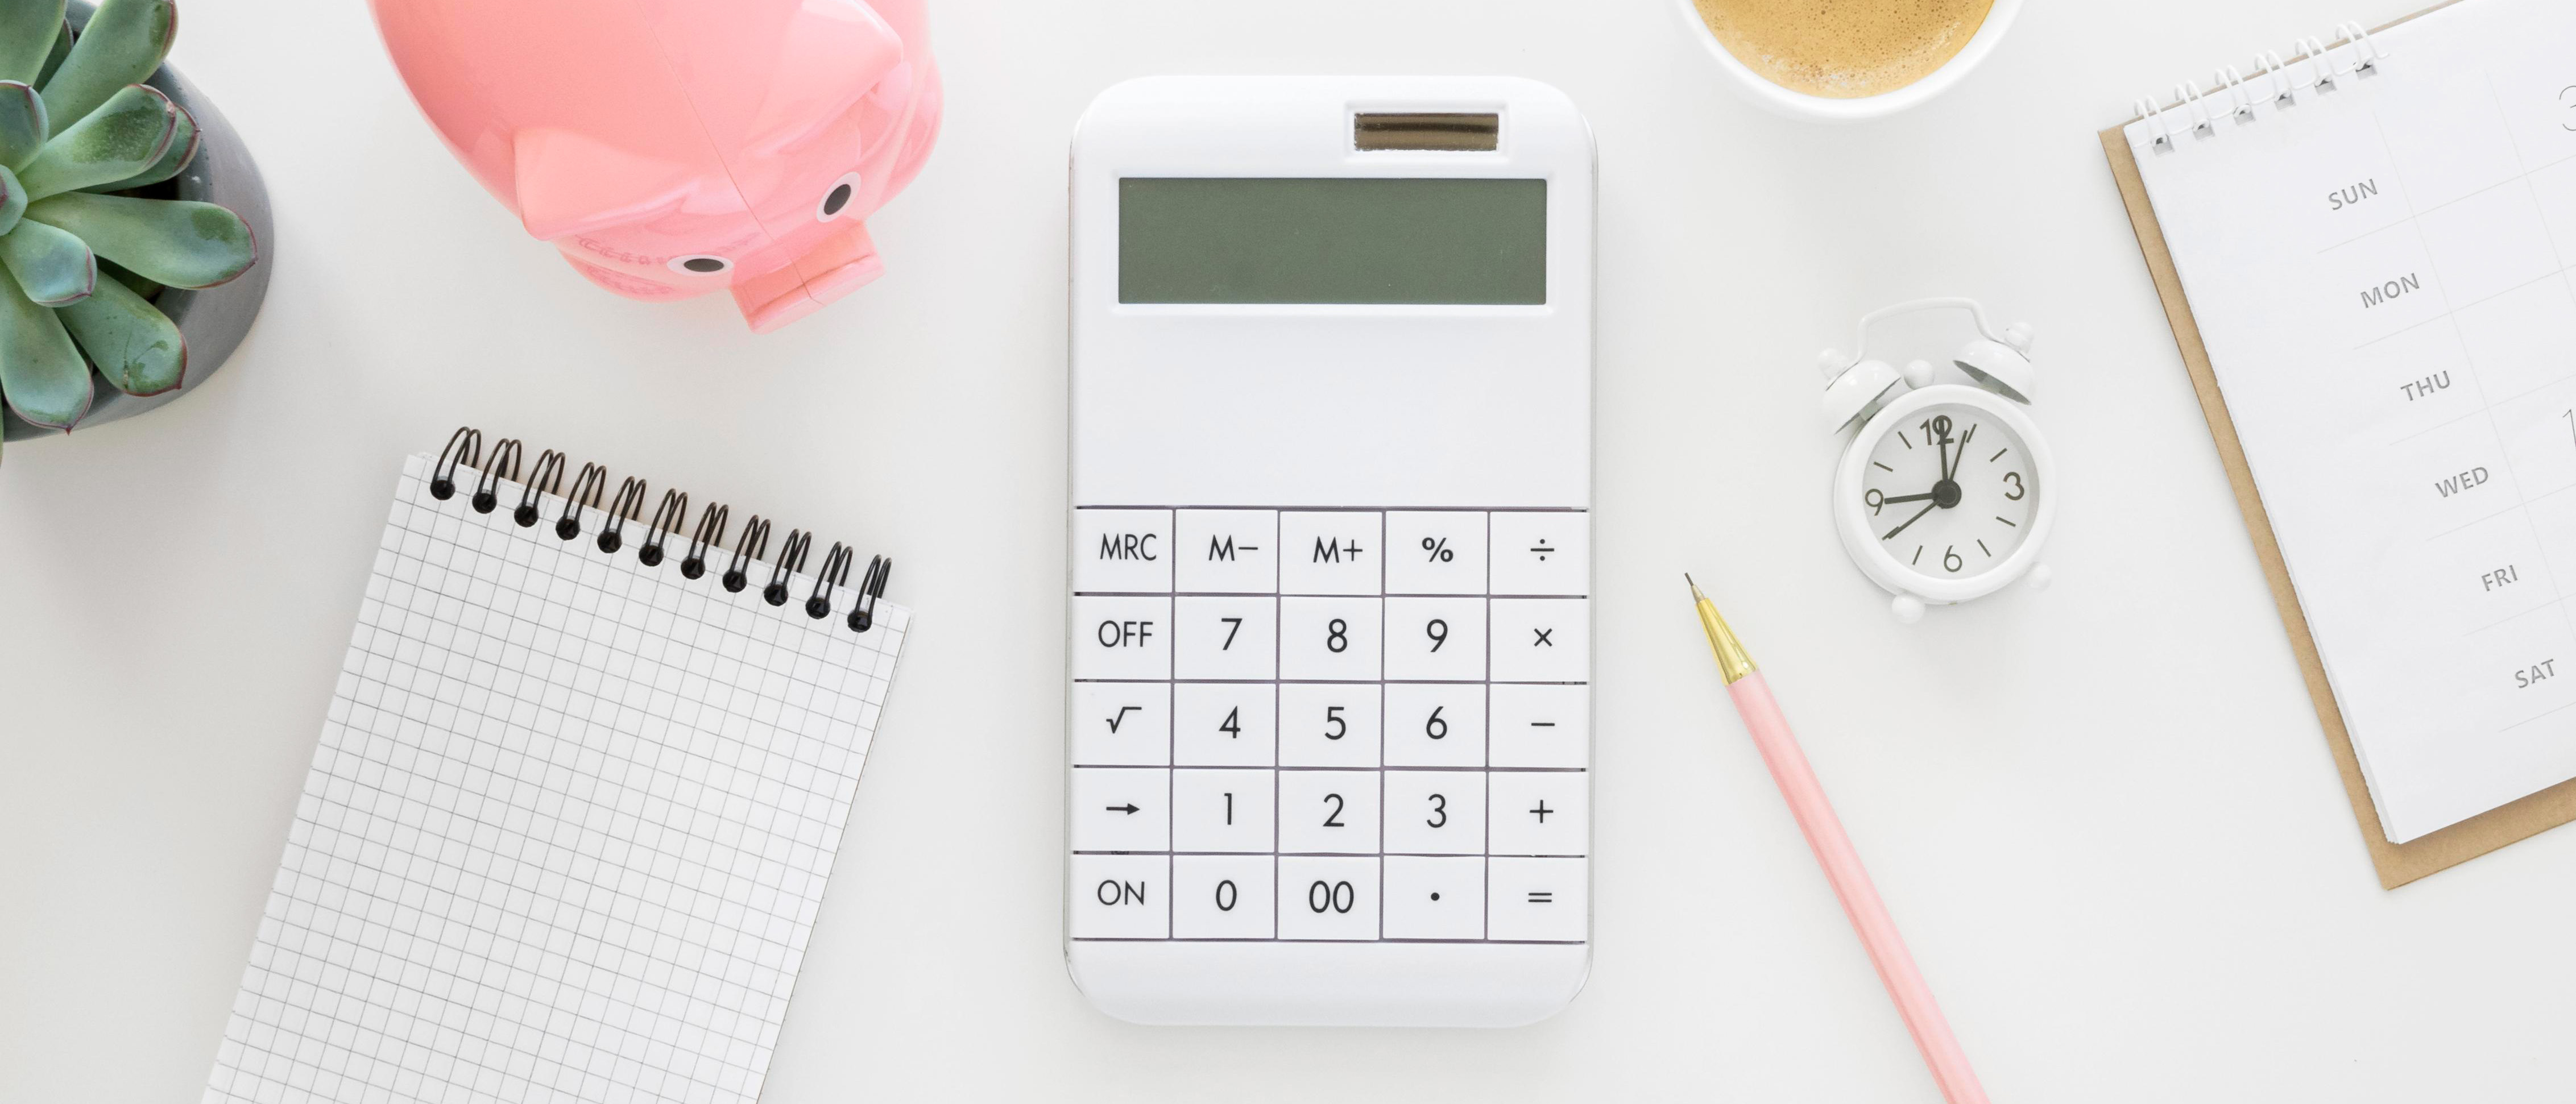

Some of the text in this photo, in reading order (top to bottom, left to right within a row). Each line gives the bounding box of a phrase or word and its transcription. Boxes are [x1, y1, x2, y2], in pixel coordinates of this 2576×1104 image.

[2328, 179, 2378, 210] SUN
[2360, 272, 2420, 309] MON
[2400, 370, 2450, 401] THU
[1920, 414, 1954, 448] 12
[2003, 471, 2024, 501] 3
[2434, 467, 2488, 498] WED
[1865, 488, 1884, 516] 9
[1100, 533, 1157, 561] MRC
[1313, 536, 1363, 563] M+
[1422, 537, 1453, 562] %
[1944, 545, 1962, 572] 6
[2481, 565, 2518, 592] FRI
[1098, 620, 1153, 648] OFF
[1221, 617, 1243, 650] 7
[1327, 619, 1348, 653] 8
[1426, 619, 1448, 653] 9
[2515, 658, 2554, 689] SAT
[1219, 705, 1241, 739] 4
[1324, 706, 1346, 740] 5
[1426, 706, 1448, 740] 6
[1224, 792, 1232, 825] 1
[1323, 793, 1345, 827] 2
[1426, 794, 1447, 828] 3
[1097, 879, 1145, 906] ON
[1215, 879, 1237, 911] 0
[1308, 880, 1355, 914] 00
